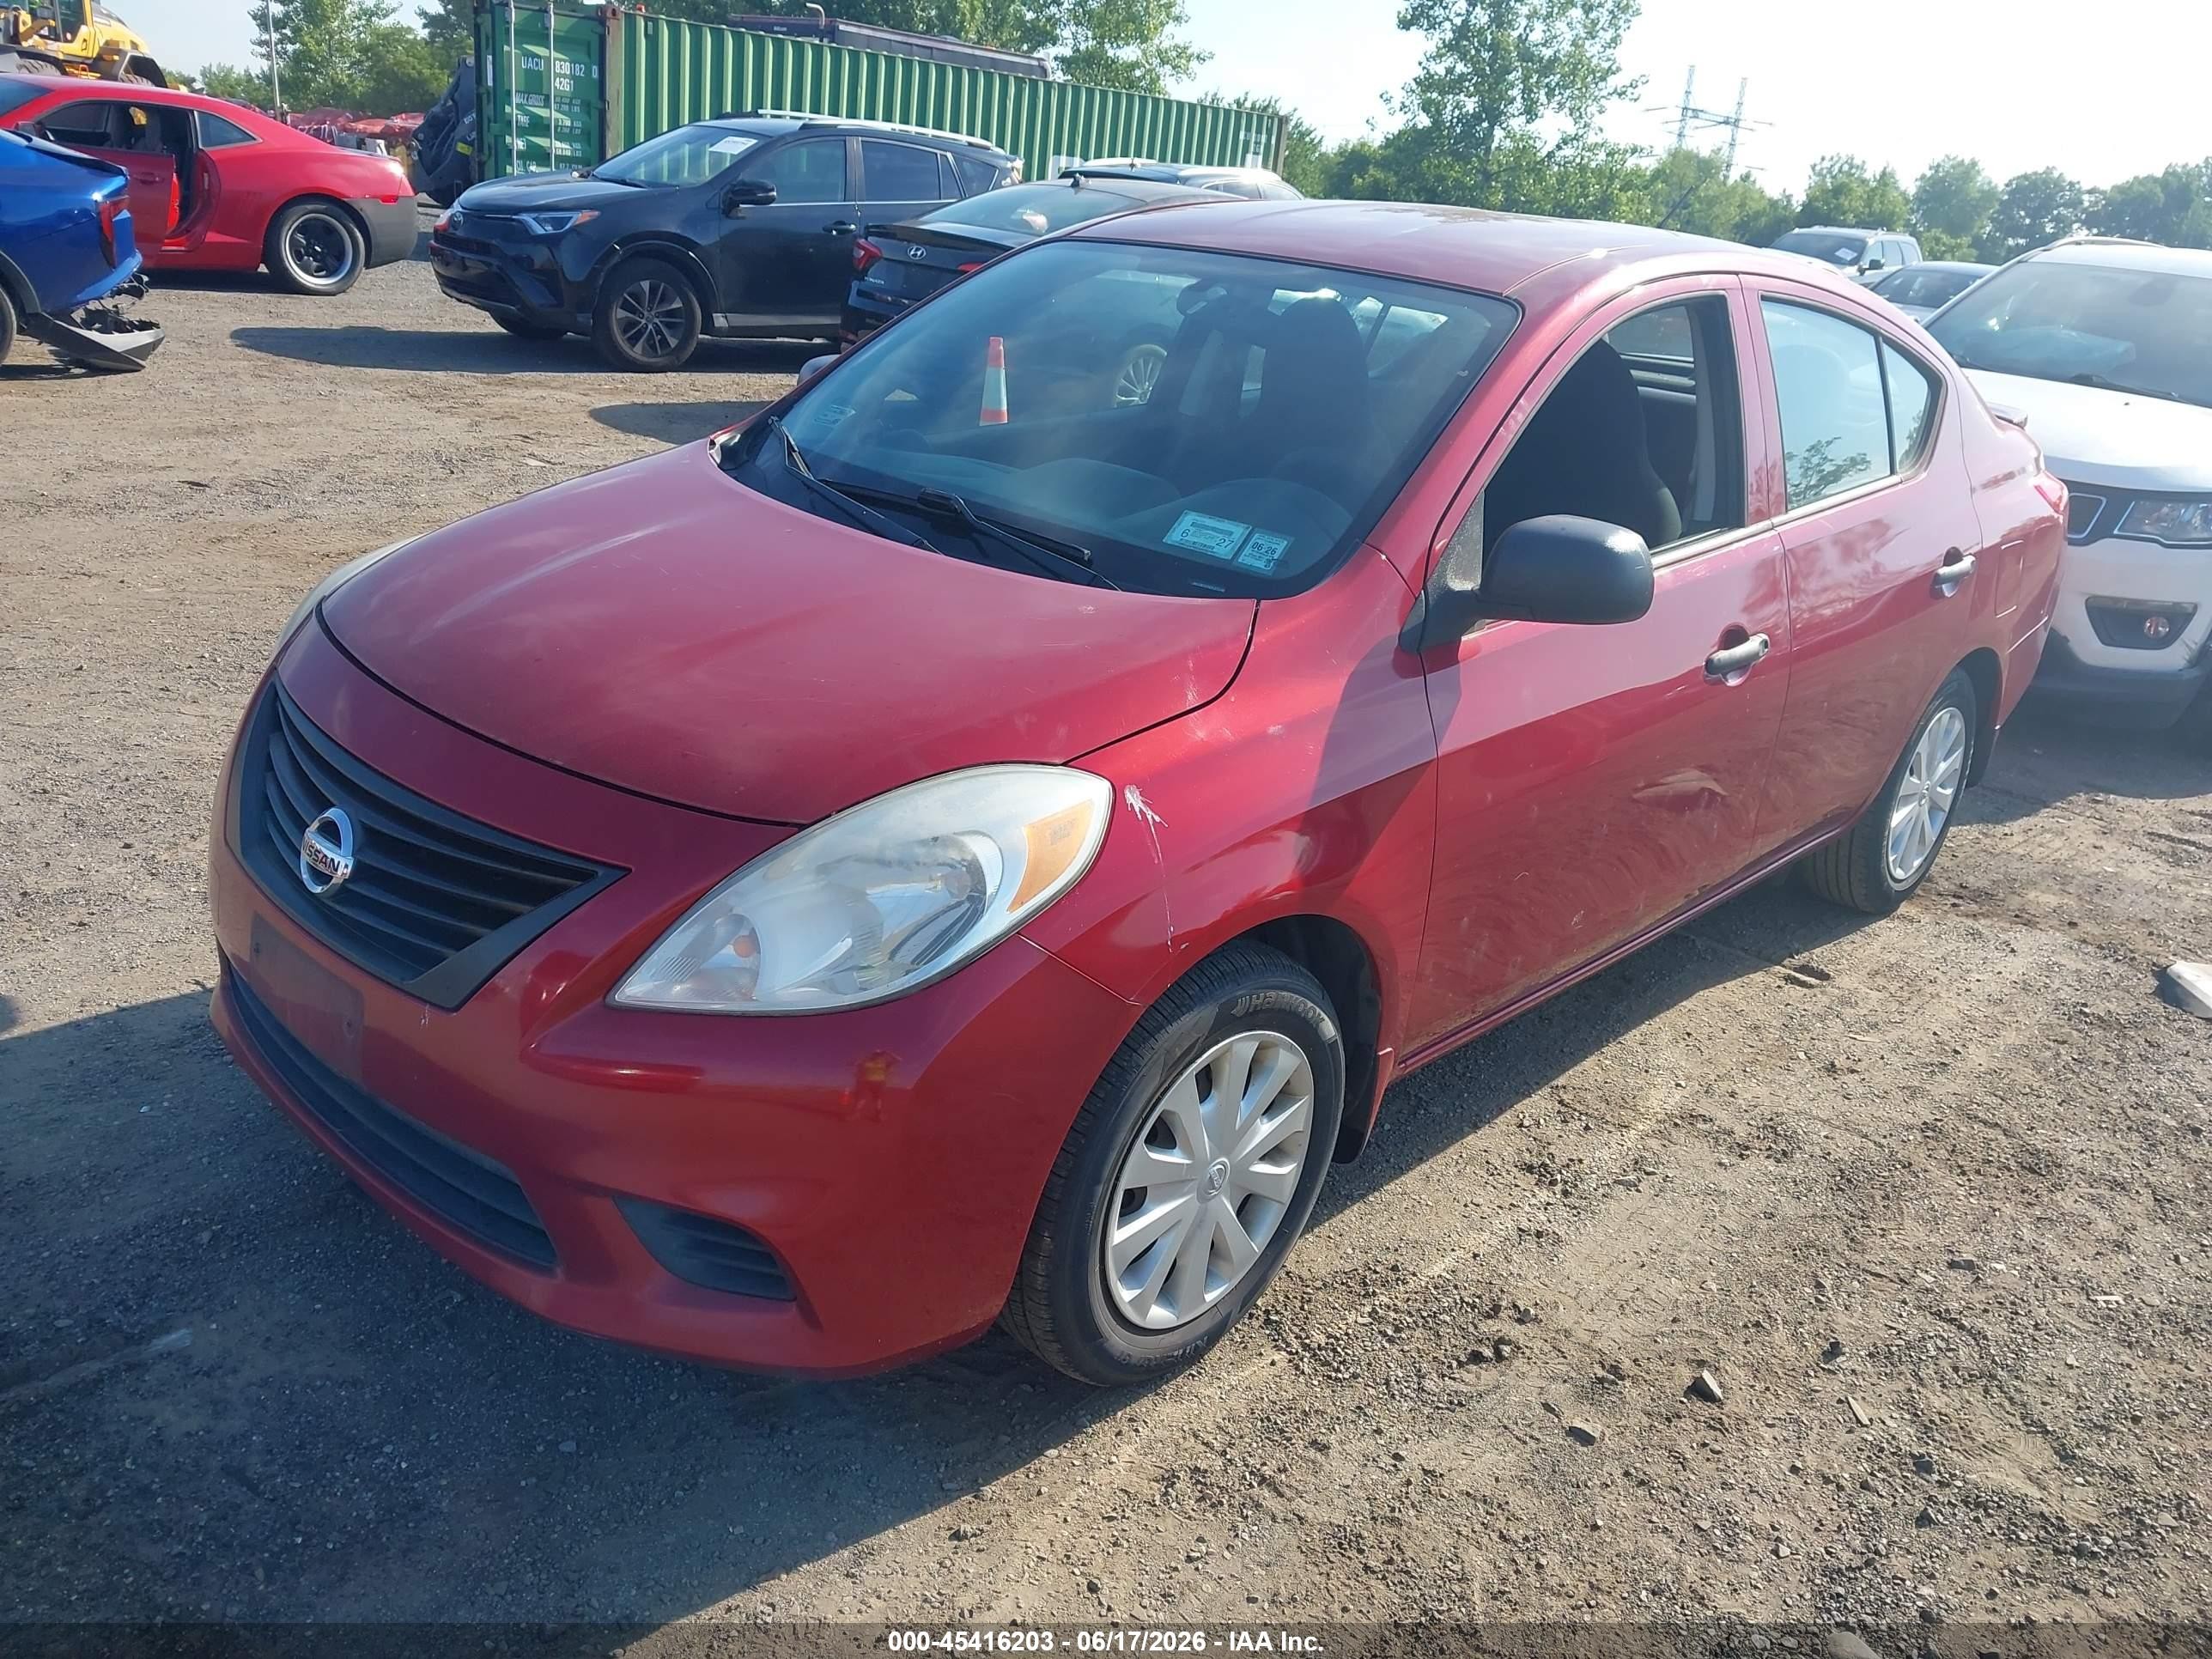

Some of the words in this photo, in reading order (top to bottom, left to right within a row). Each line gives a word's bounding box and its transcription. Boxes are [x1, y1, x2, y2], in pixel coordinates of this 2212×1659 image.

[521, 56, 544, 71] UACU
[555, 60, 585, 77] 830182
[555, 77, 574, 92] 42G1
[1181, 529, 1191, 538] 6
[1215, 538, 1235, 549] 27
[302, 838, 341, 874] NISSAN
